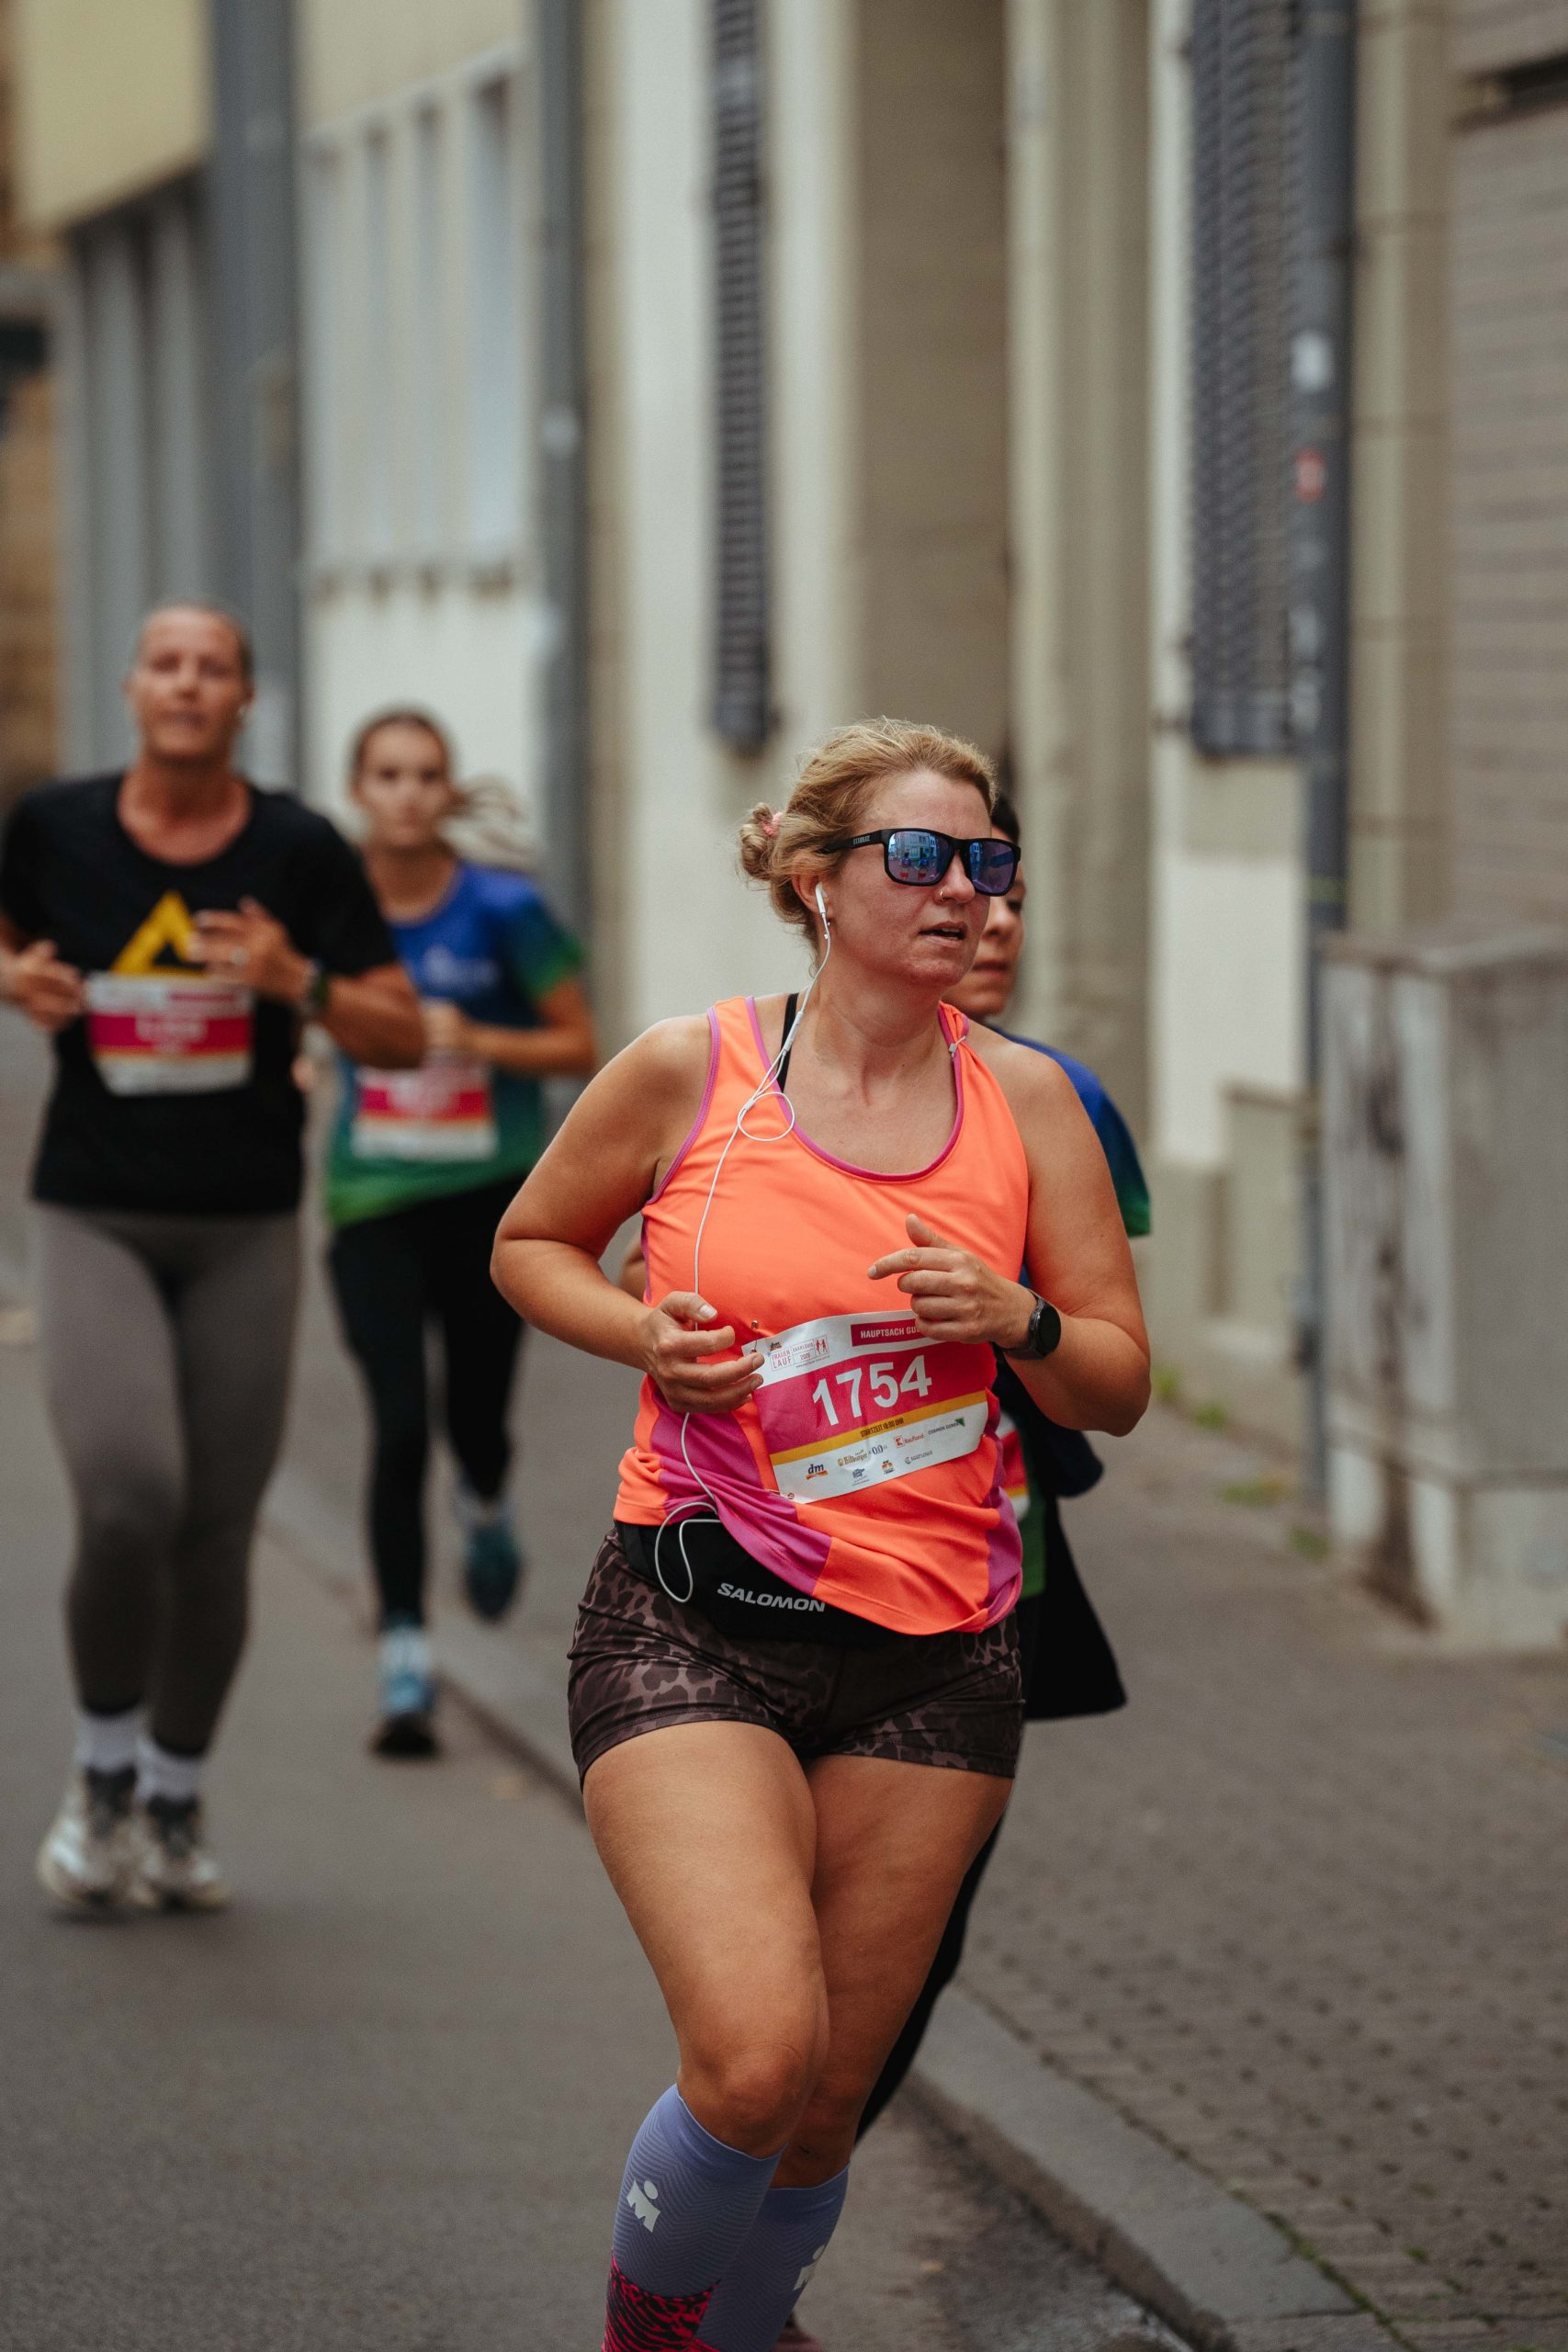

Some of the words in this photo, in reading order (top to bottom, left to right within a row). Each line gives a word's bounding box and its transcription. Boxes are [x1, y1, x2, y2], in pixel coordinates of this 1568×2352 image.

[861, 1328, 904, 1339] HAUPTSACH
[773, 1358, 792, 1369] LAUF
[812, 1354, 932, 1426] 1754
[808, 1464, 824, 1475] dm
[716, 1582, 826, 1612] SALOMON
